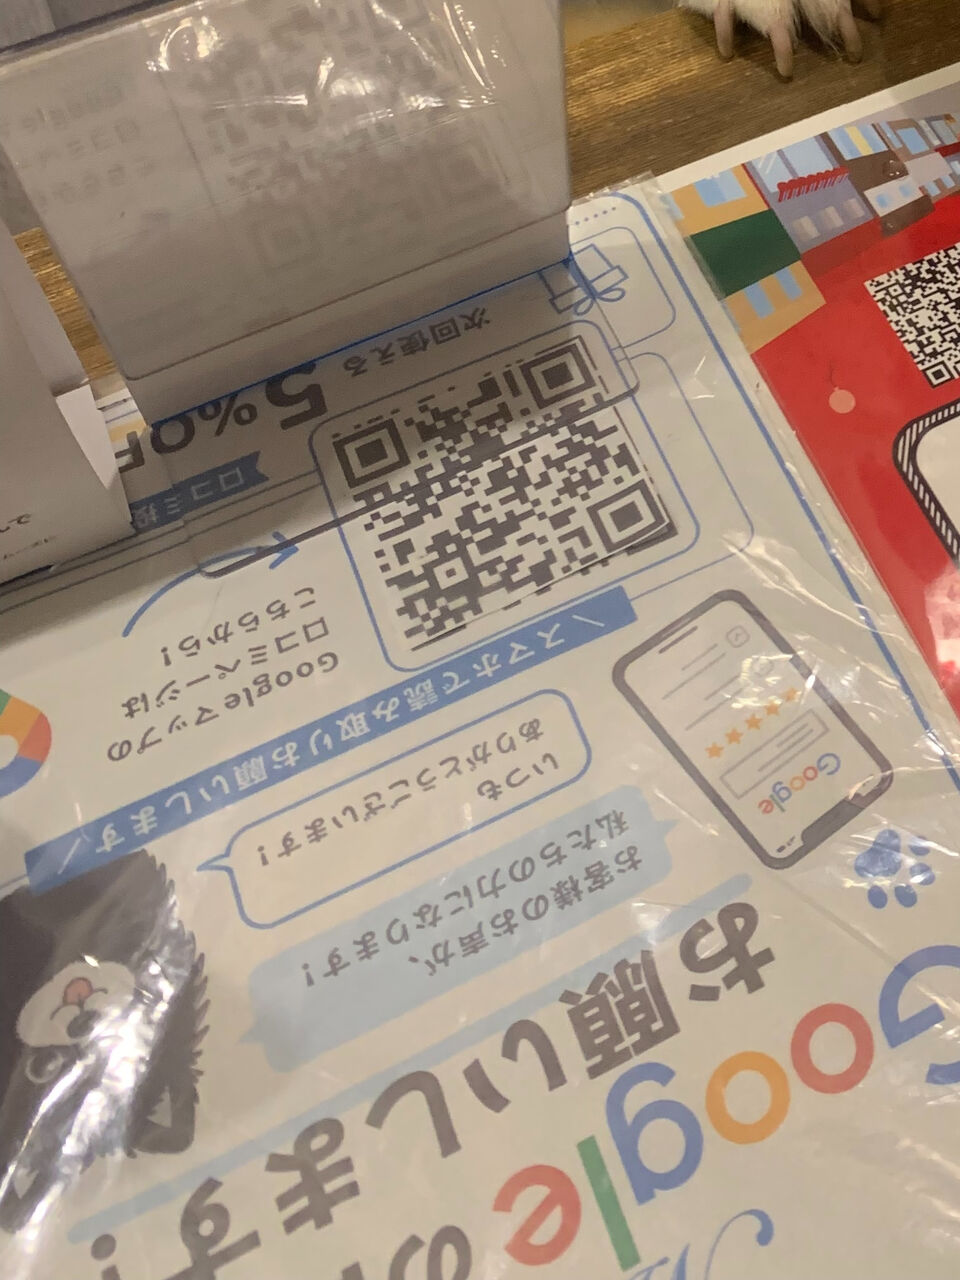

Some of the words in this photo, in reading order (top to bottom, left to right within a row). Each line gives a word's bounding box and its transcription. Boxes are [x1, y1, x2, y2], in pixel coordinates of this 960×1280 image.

[343, 308, 490, 377] 次回使える
[161, 588, 315, 666] こちらから！
[258, 719, 543, 866] ありがとうございます！
[477, 753, 558, 800] いつも
[758, 753, 841, 814] Google
[302, 810, 628, 986] 私たちの力になります！
